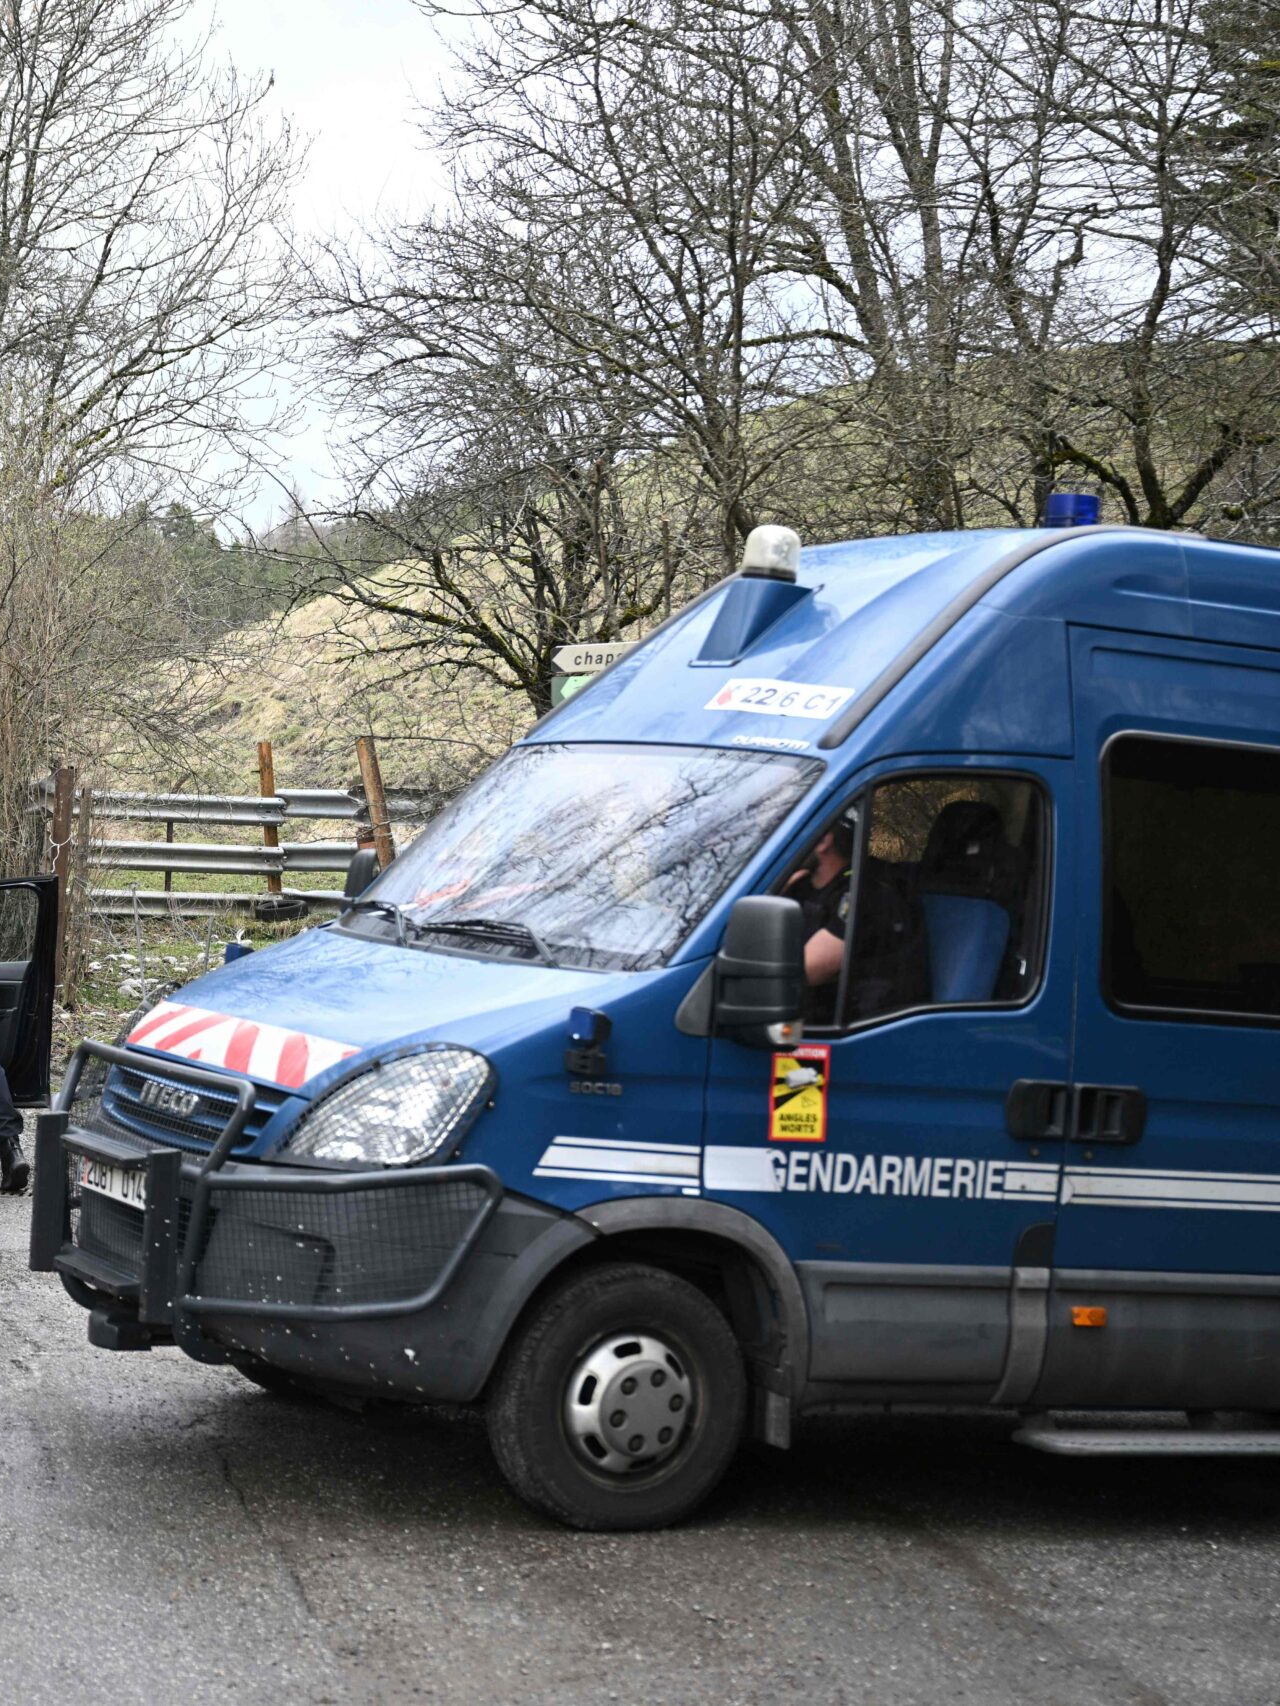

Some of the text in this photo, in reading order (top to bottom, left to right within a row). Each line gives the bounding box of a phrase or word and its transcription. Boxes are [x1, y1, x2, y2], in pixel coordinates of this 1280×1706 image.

[573, 651, 623, 667] chap
[140, 1080, 199, 1116] IVECO
[780, 1113, 818, 1122] ANGLES
[780, 1124, 816, 1133] MORTS
[769, 1148, 1004, 1200] GENDARMERIE
